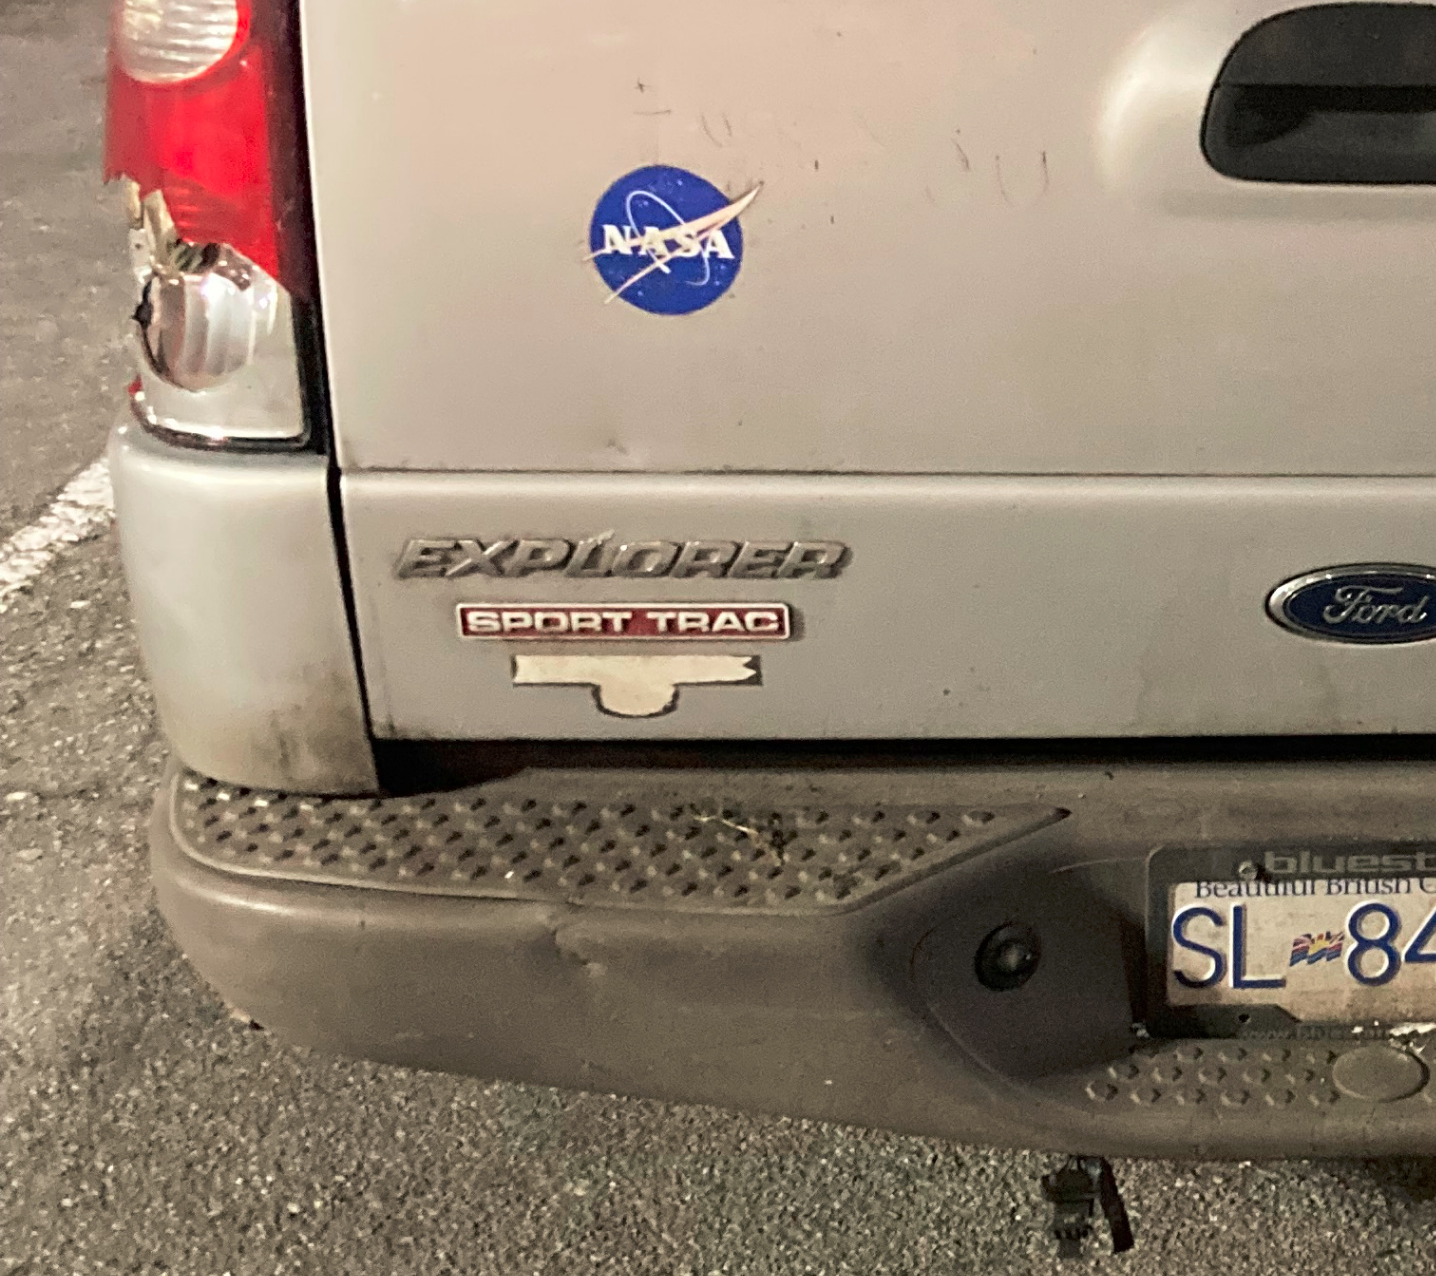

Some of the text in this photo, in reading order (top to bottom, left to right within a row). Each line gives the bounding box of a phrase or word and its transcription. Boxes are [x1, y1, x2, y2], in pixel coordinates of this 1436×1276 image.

[602, 224, 736, 260] NASA
[396, 535, 853, 579] EXPLORER
[466, 611, 780, 633] SPORT TRAC
[1322, 584, 1430, 624] Ford
